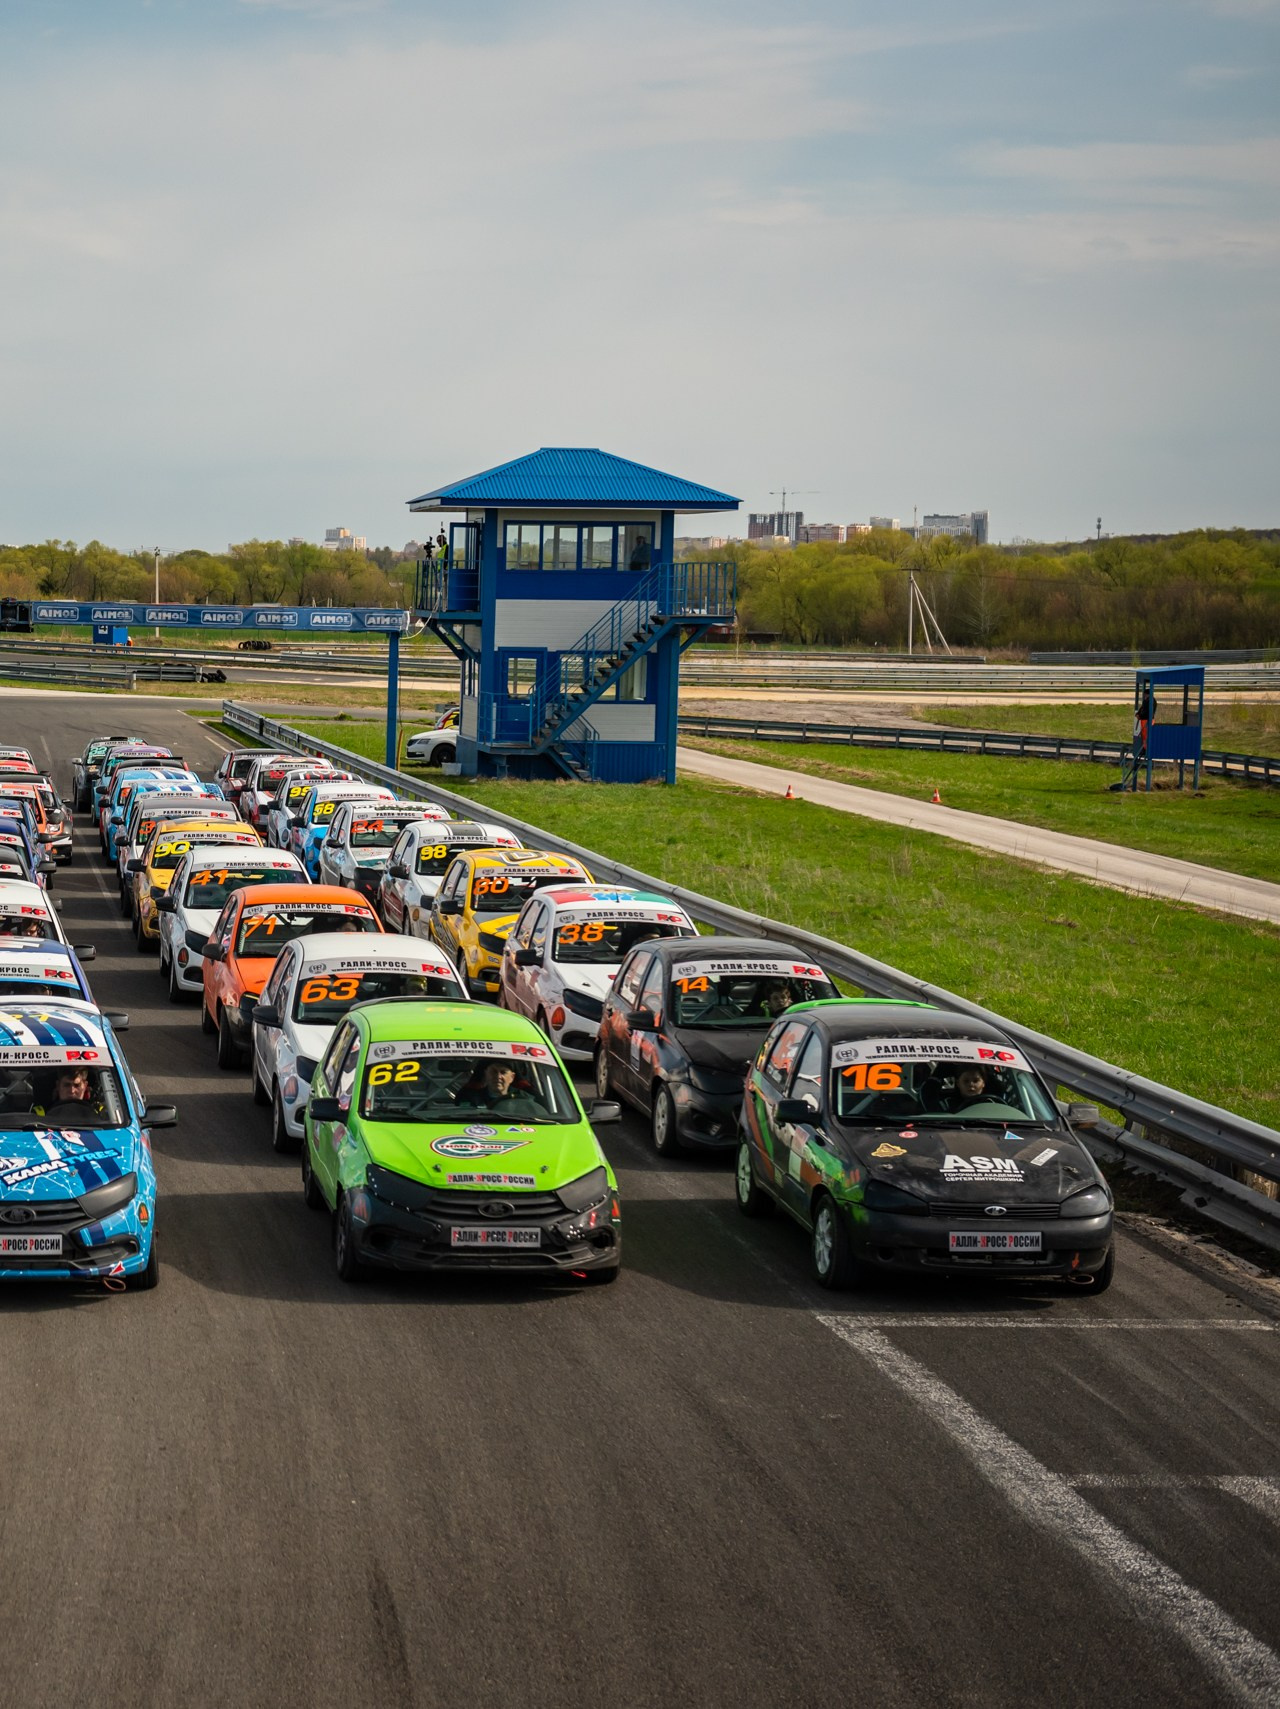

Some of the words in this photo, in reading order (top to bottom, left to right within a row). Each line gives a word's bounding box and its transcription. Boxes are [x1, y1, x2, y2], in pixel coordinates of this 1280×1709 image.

[39, 608, 77, 618] AIMOL
[94, 610, 132, 619] AIMOL
[148, 611, 186, 620] AIMOL
[203, 612, 241, 622] AIMOL
[258, 614, 295, 624] AIMOL
[313, 615, 350, 624] AIMOL
[313, 803, 335, 816] 58
[351, 820, 384, 833] 24
[154, 841, 191, 858] 90
[421, 845, 447, 861] 98
[190, 869, 228, 886] 41
[473, 877, 509, 895] 80
[243, 917, 277, 938] 71
[559, 924, 604, 944] 38
[301, 978, 360, 1003] 63
[676, 976, 710, 994] 14
[412, 1041, 494, 1050] РАЛЛИ-КРОСС
[875, 1045, 960, 1054] РАЛЛИ-КРОСС
[368, 1061, 421, 1086] 62
[841, 1063, 903, 1091] 16
[3, 1159, 68, 1186] KAMA
[62, 1149, 119, 1164] TYRES
[942, 1155, 1019, 1170] ASM
[448, 1174, 502, 1184] РАЛЛИ-КРОСС
[503, 1175, 535, 1185] РОССИИ
[453, 1231, 507, 1243] РАЛЛИ-КРОСС
[508, 1231, 539, 1243] РОССИИ
[951, 1235, 1007, 1248] РАЛЛИ-КРОСС
[1008, 1235, 1040, 1247] РОССИИ
[29, 1238, 61, 1251] РОССИИ
